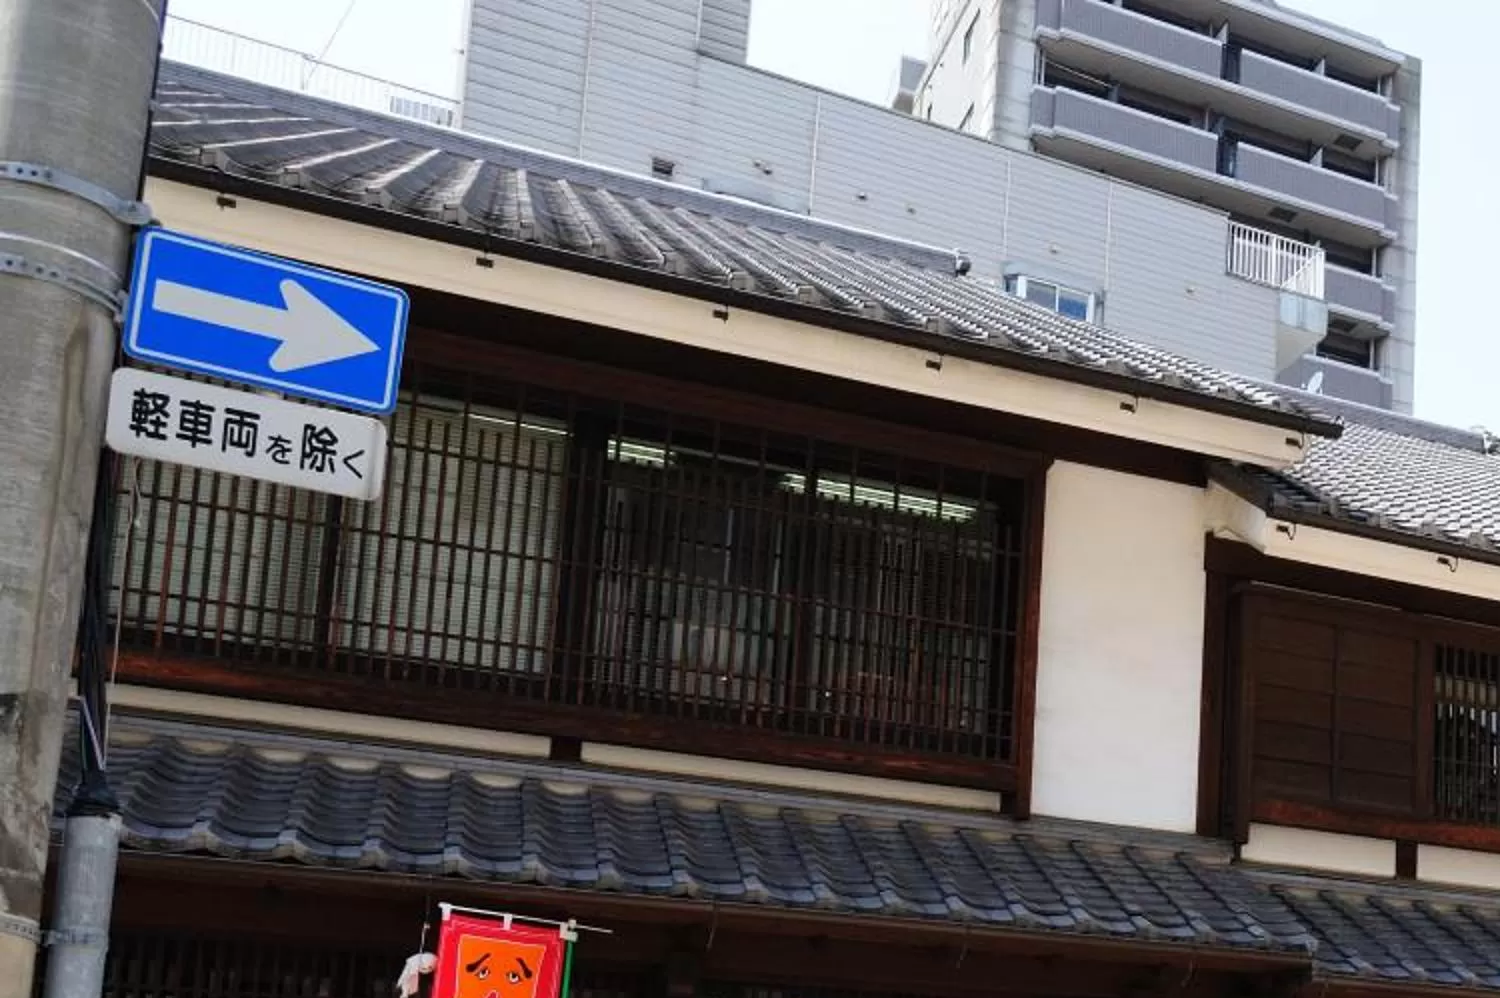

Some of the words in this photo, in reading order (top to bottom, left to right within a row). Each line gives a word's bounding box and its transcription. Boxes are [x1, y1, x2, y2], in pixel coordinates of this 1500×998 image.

[129, 388, 365, 479] 軽車両を除く
